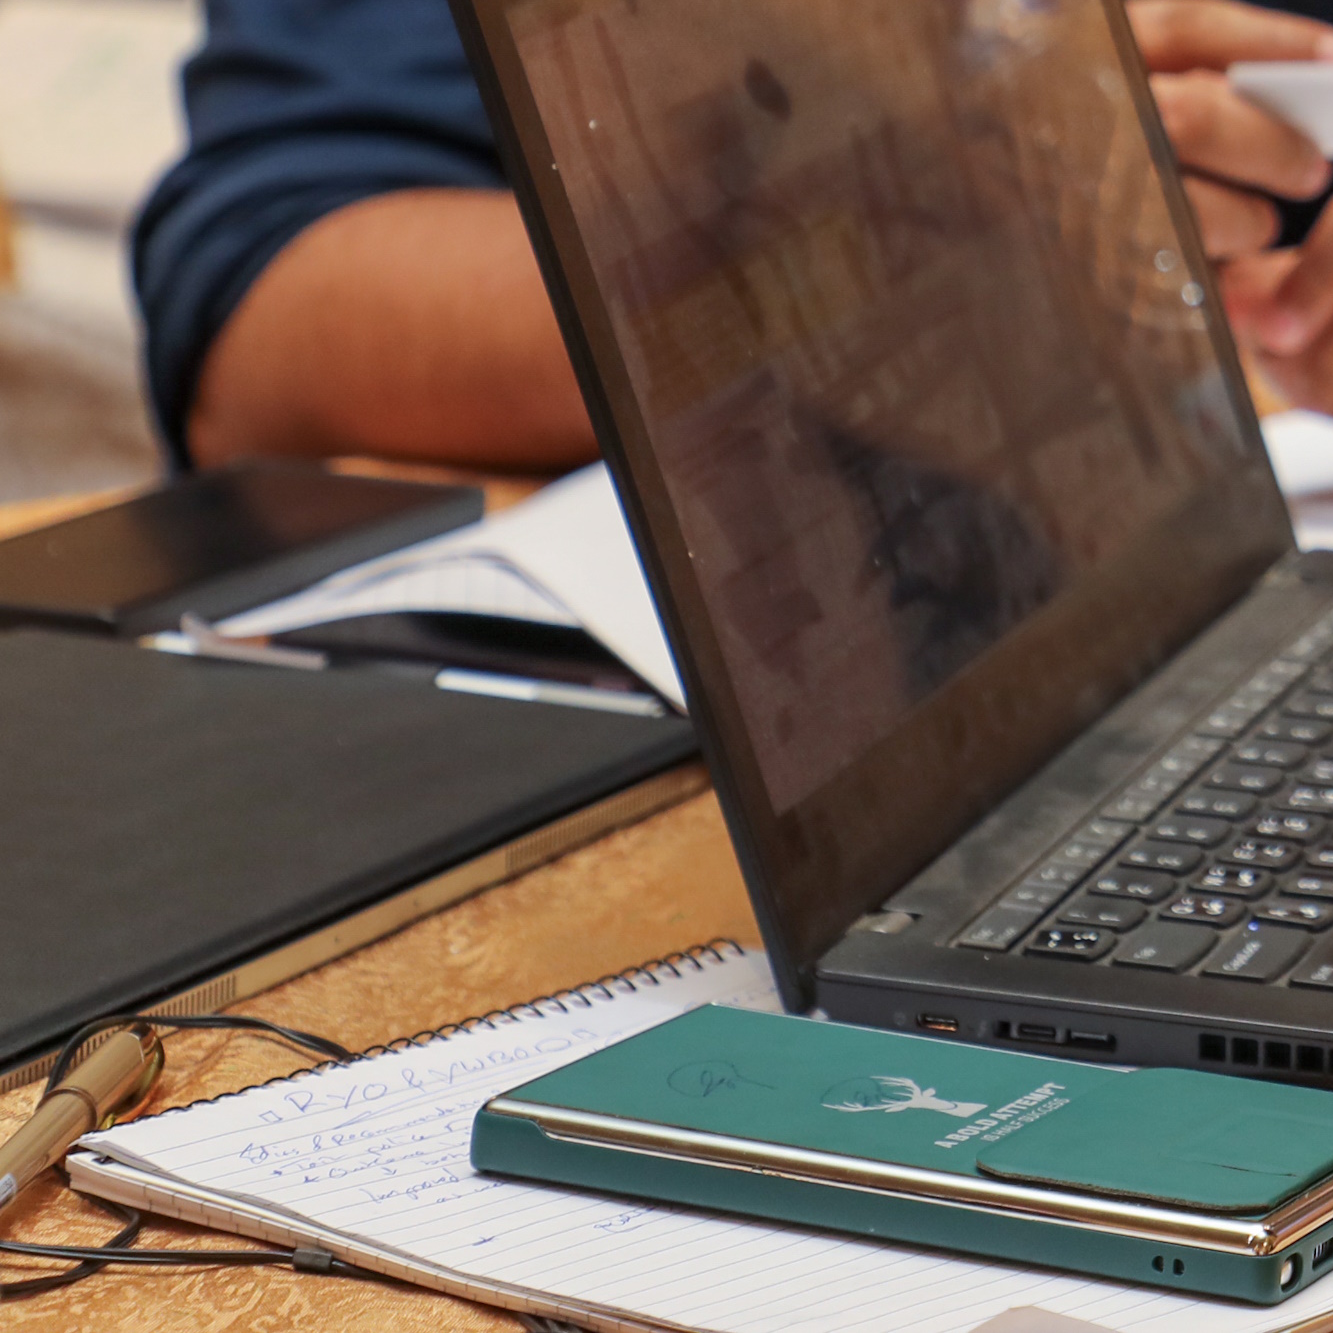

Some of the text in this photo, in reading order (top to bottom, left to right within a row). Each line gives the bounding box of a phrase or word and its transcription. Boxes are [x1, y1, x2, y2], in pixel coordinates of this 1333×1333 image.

[934, 1082, 1066, 1149] A BOLD ATTEMPT
